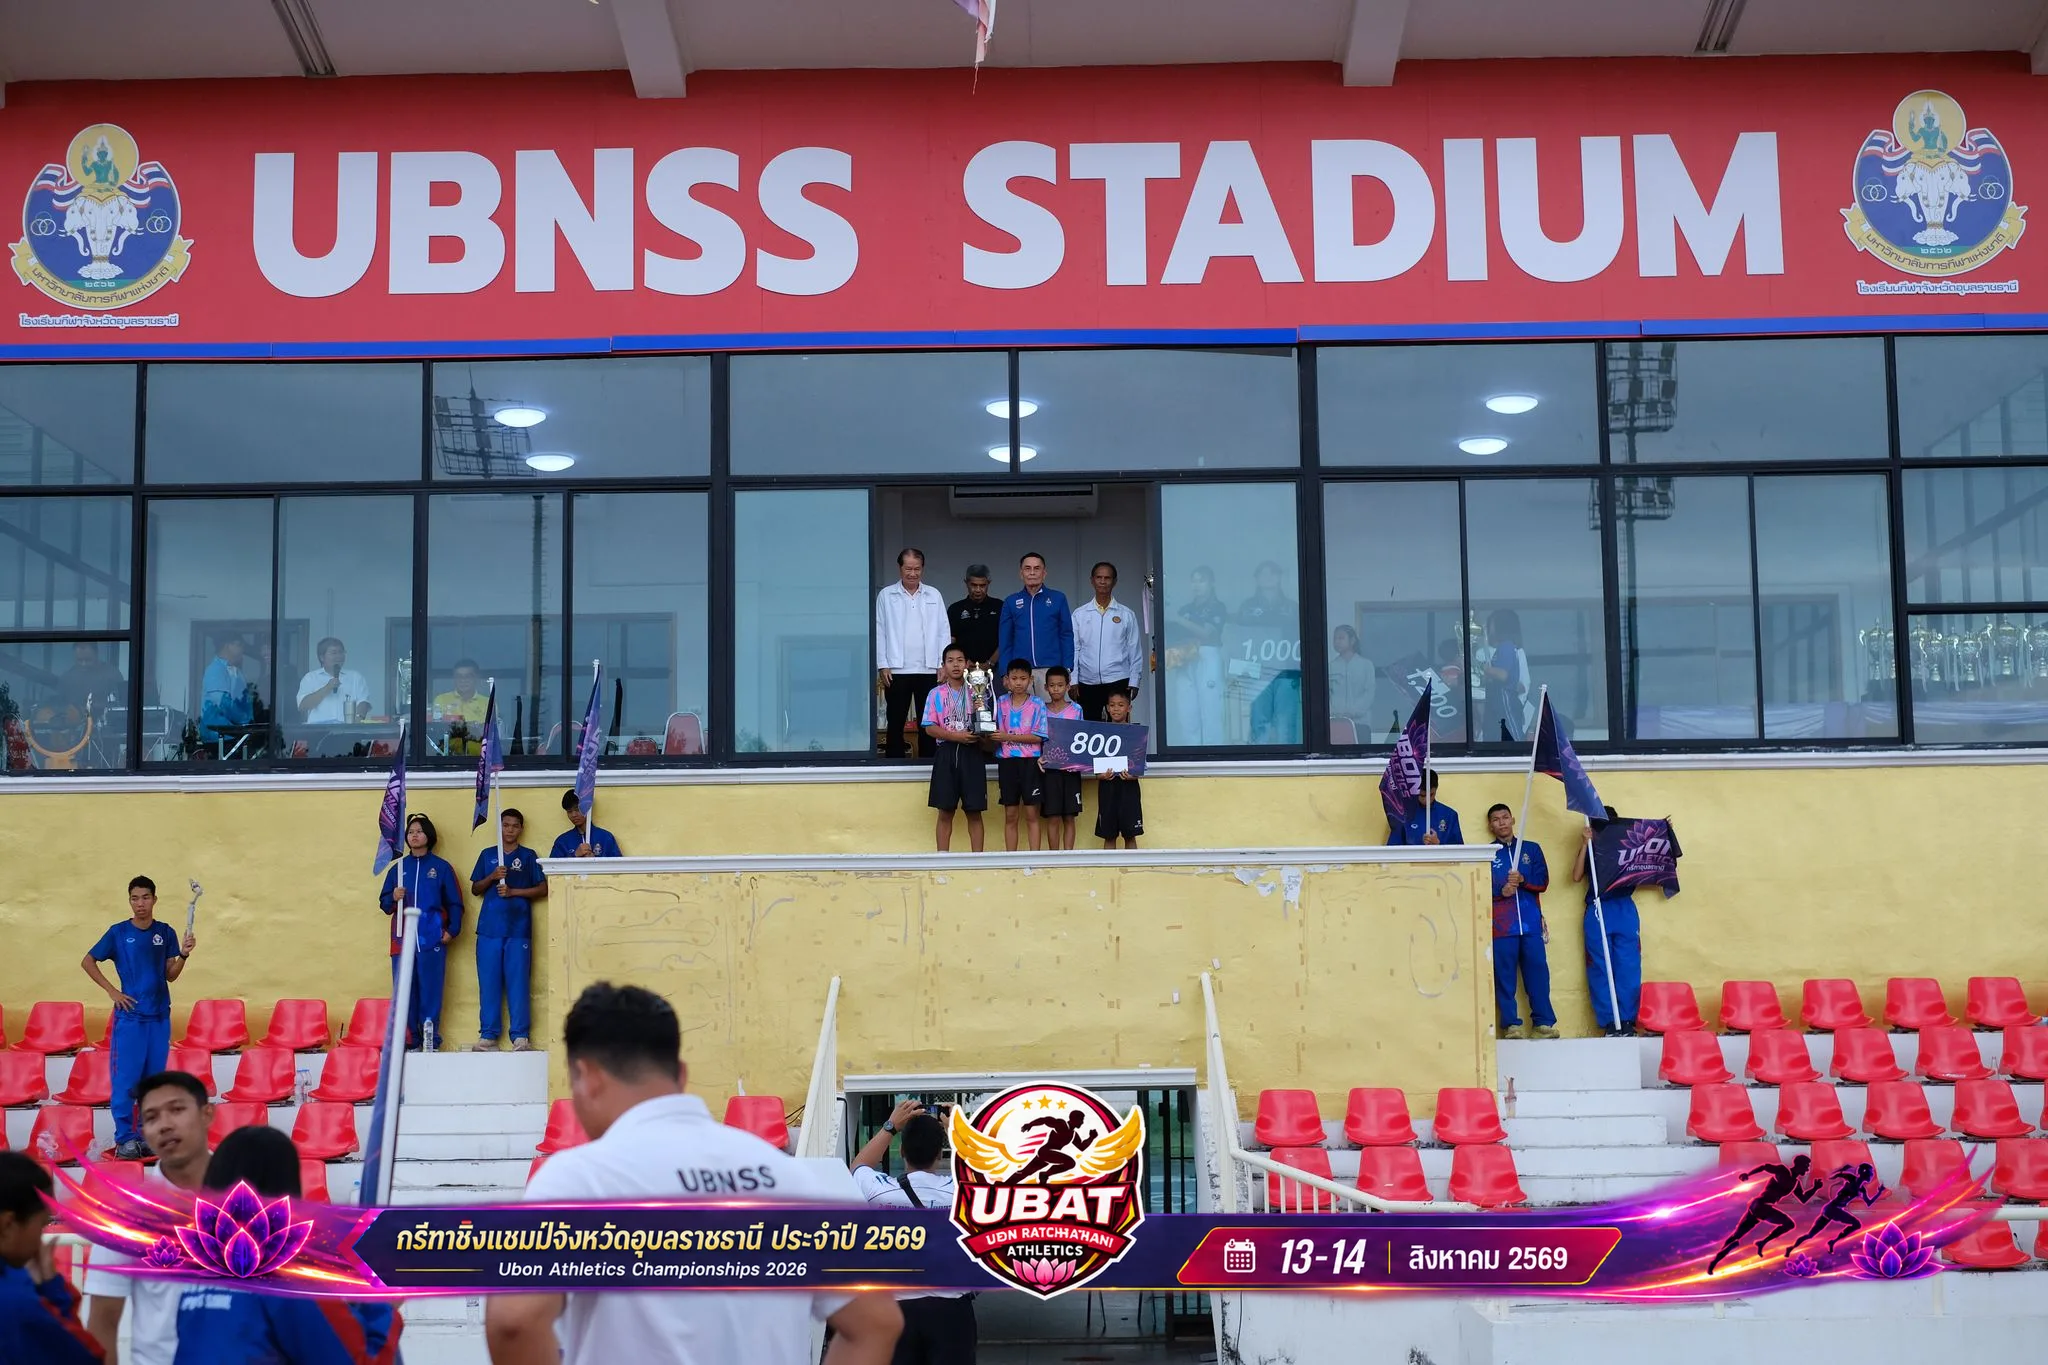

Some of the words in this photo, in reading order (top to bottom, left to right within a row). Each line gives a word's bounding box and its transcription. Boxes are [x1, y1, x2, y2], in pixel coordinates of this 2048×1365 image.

[253, 147, 859, 297] UBNSS
[963, 132, 1784, 288] STADIUM
[1069, 731, 1122, 757] 800
[677, 1165, 776, 1193] UBNSS
